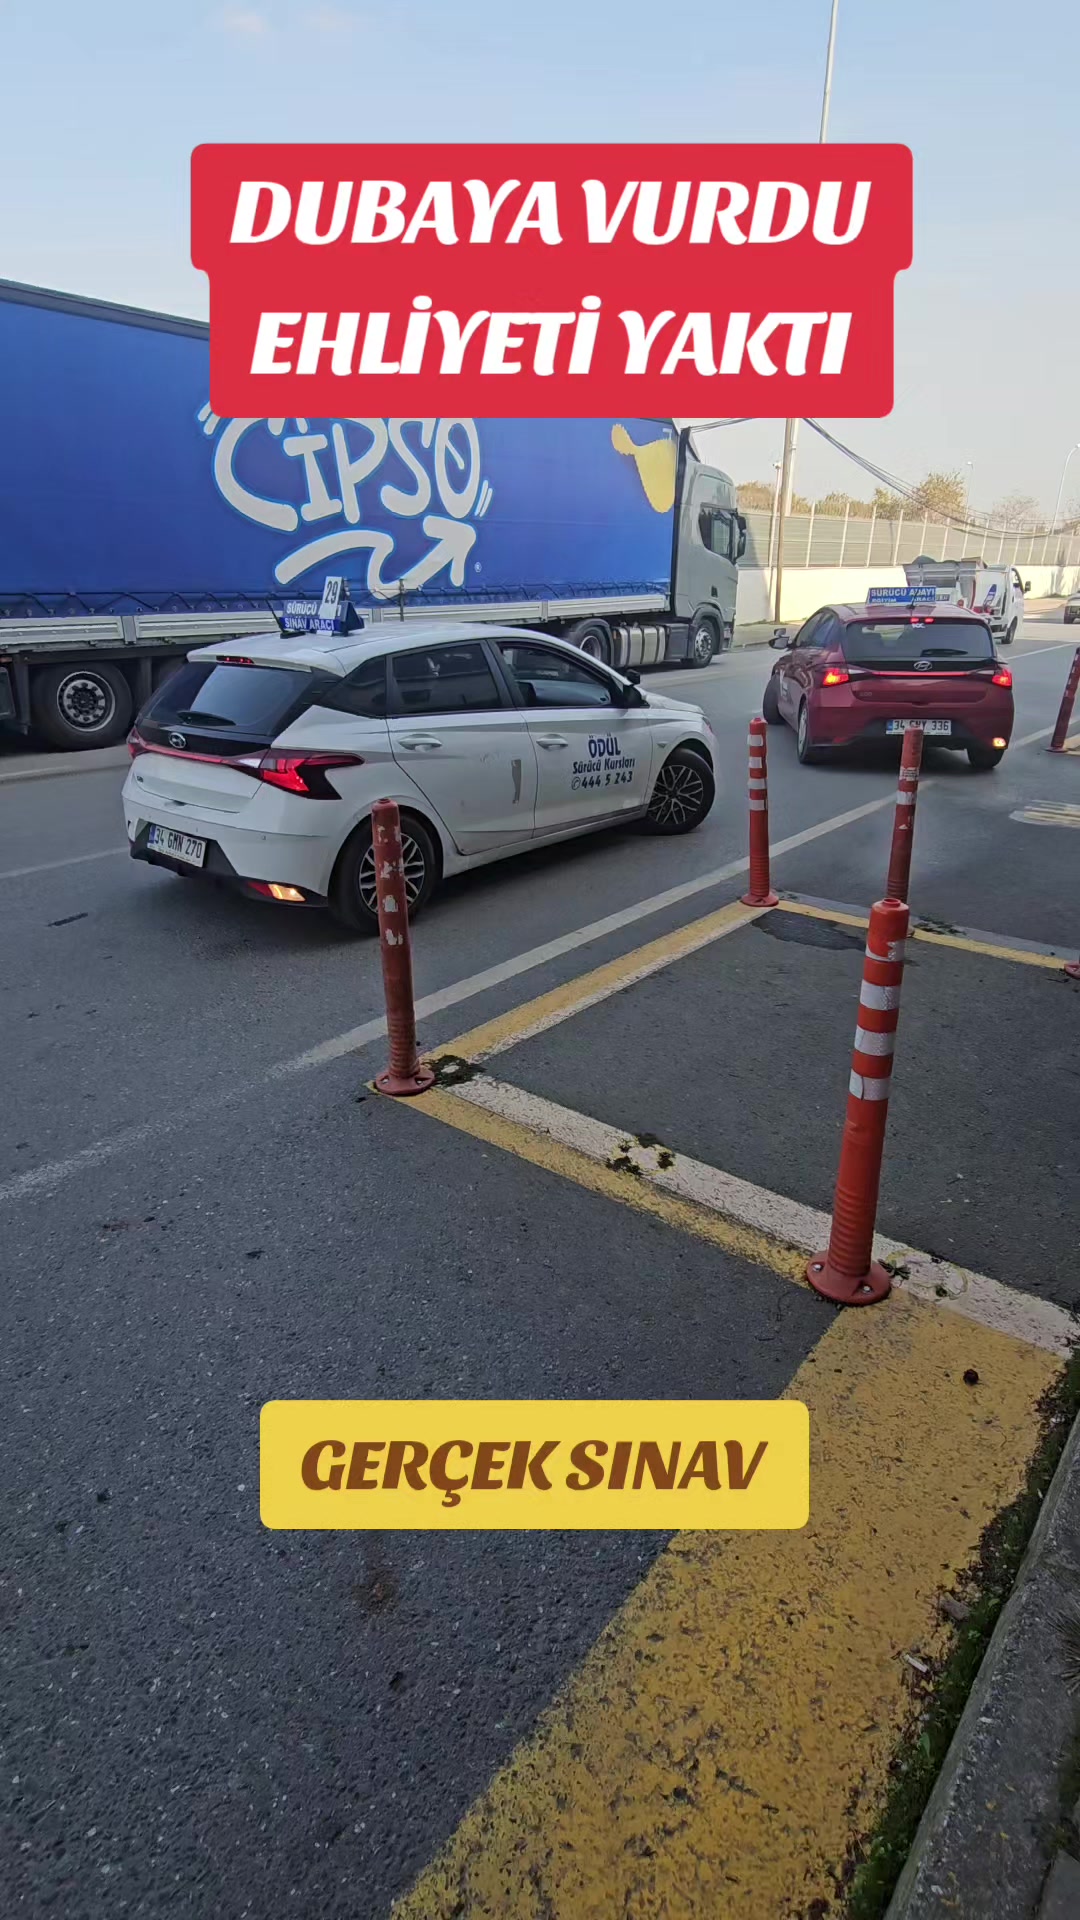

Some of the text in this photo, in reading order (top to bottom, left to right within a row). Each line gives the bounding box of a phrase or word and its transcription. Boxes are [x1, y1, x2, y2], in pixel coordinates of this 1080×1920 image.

[326, 581, 338, 604] 29
[284, 617, 335, 630] SINAV ARACI
[894, 721, 905, 731] 34
[931, 721, 949, 731] 336
[588, 733, 621, 758] ÖDÜL
[572, 760, 602, 774] Sürücü
[581, 771, 632, 788] 444 5 243
[155, 828, 164, 846] 34
[168, 832, 184, 852] GMN
[186, 839, 202, 858] 270
